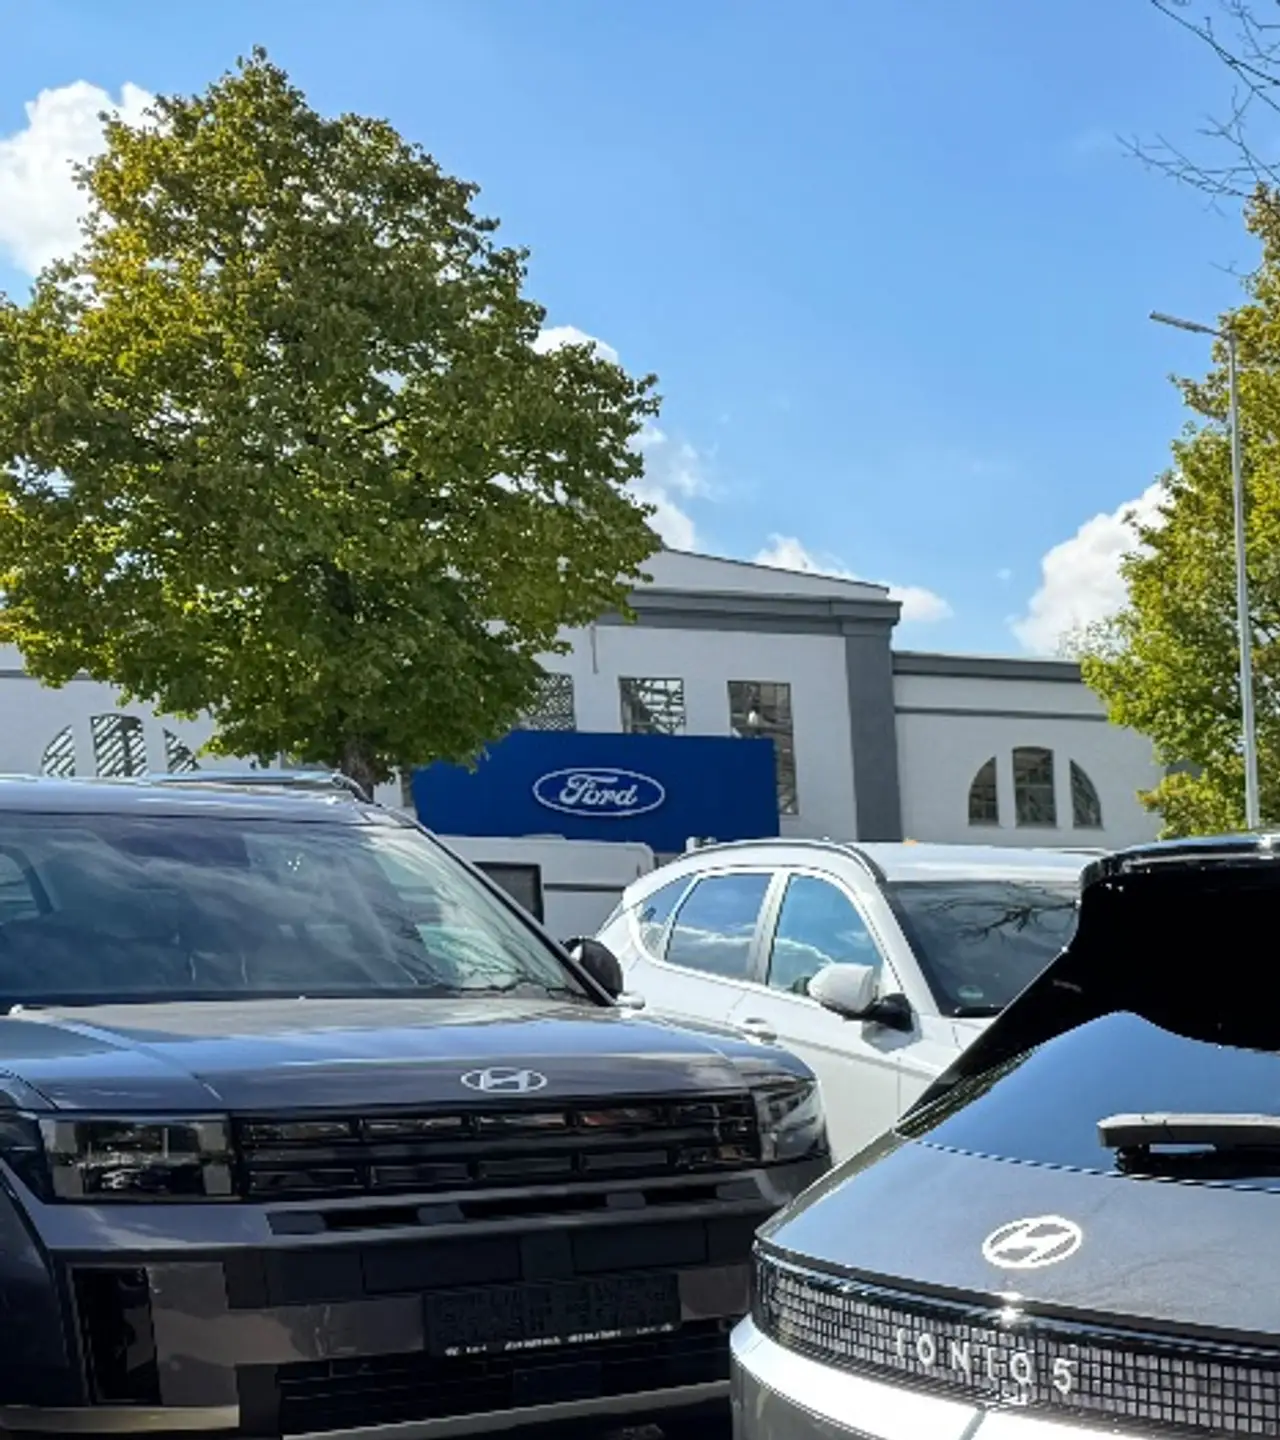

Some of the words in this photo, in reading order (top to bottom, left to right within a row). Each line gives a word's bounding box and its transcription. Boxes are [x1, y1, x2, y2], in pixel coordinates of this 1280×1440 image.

[560, 774, 638, 805] Ford
[897, 1328, 1033, 1388] IONIQ
[1053, 1357, 1077, 1395] 5
